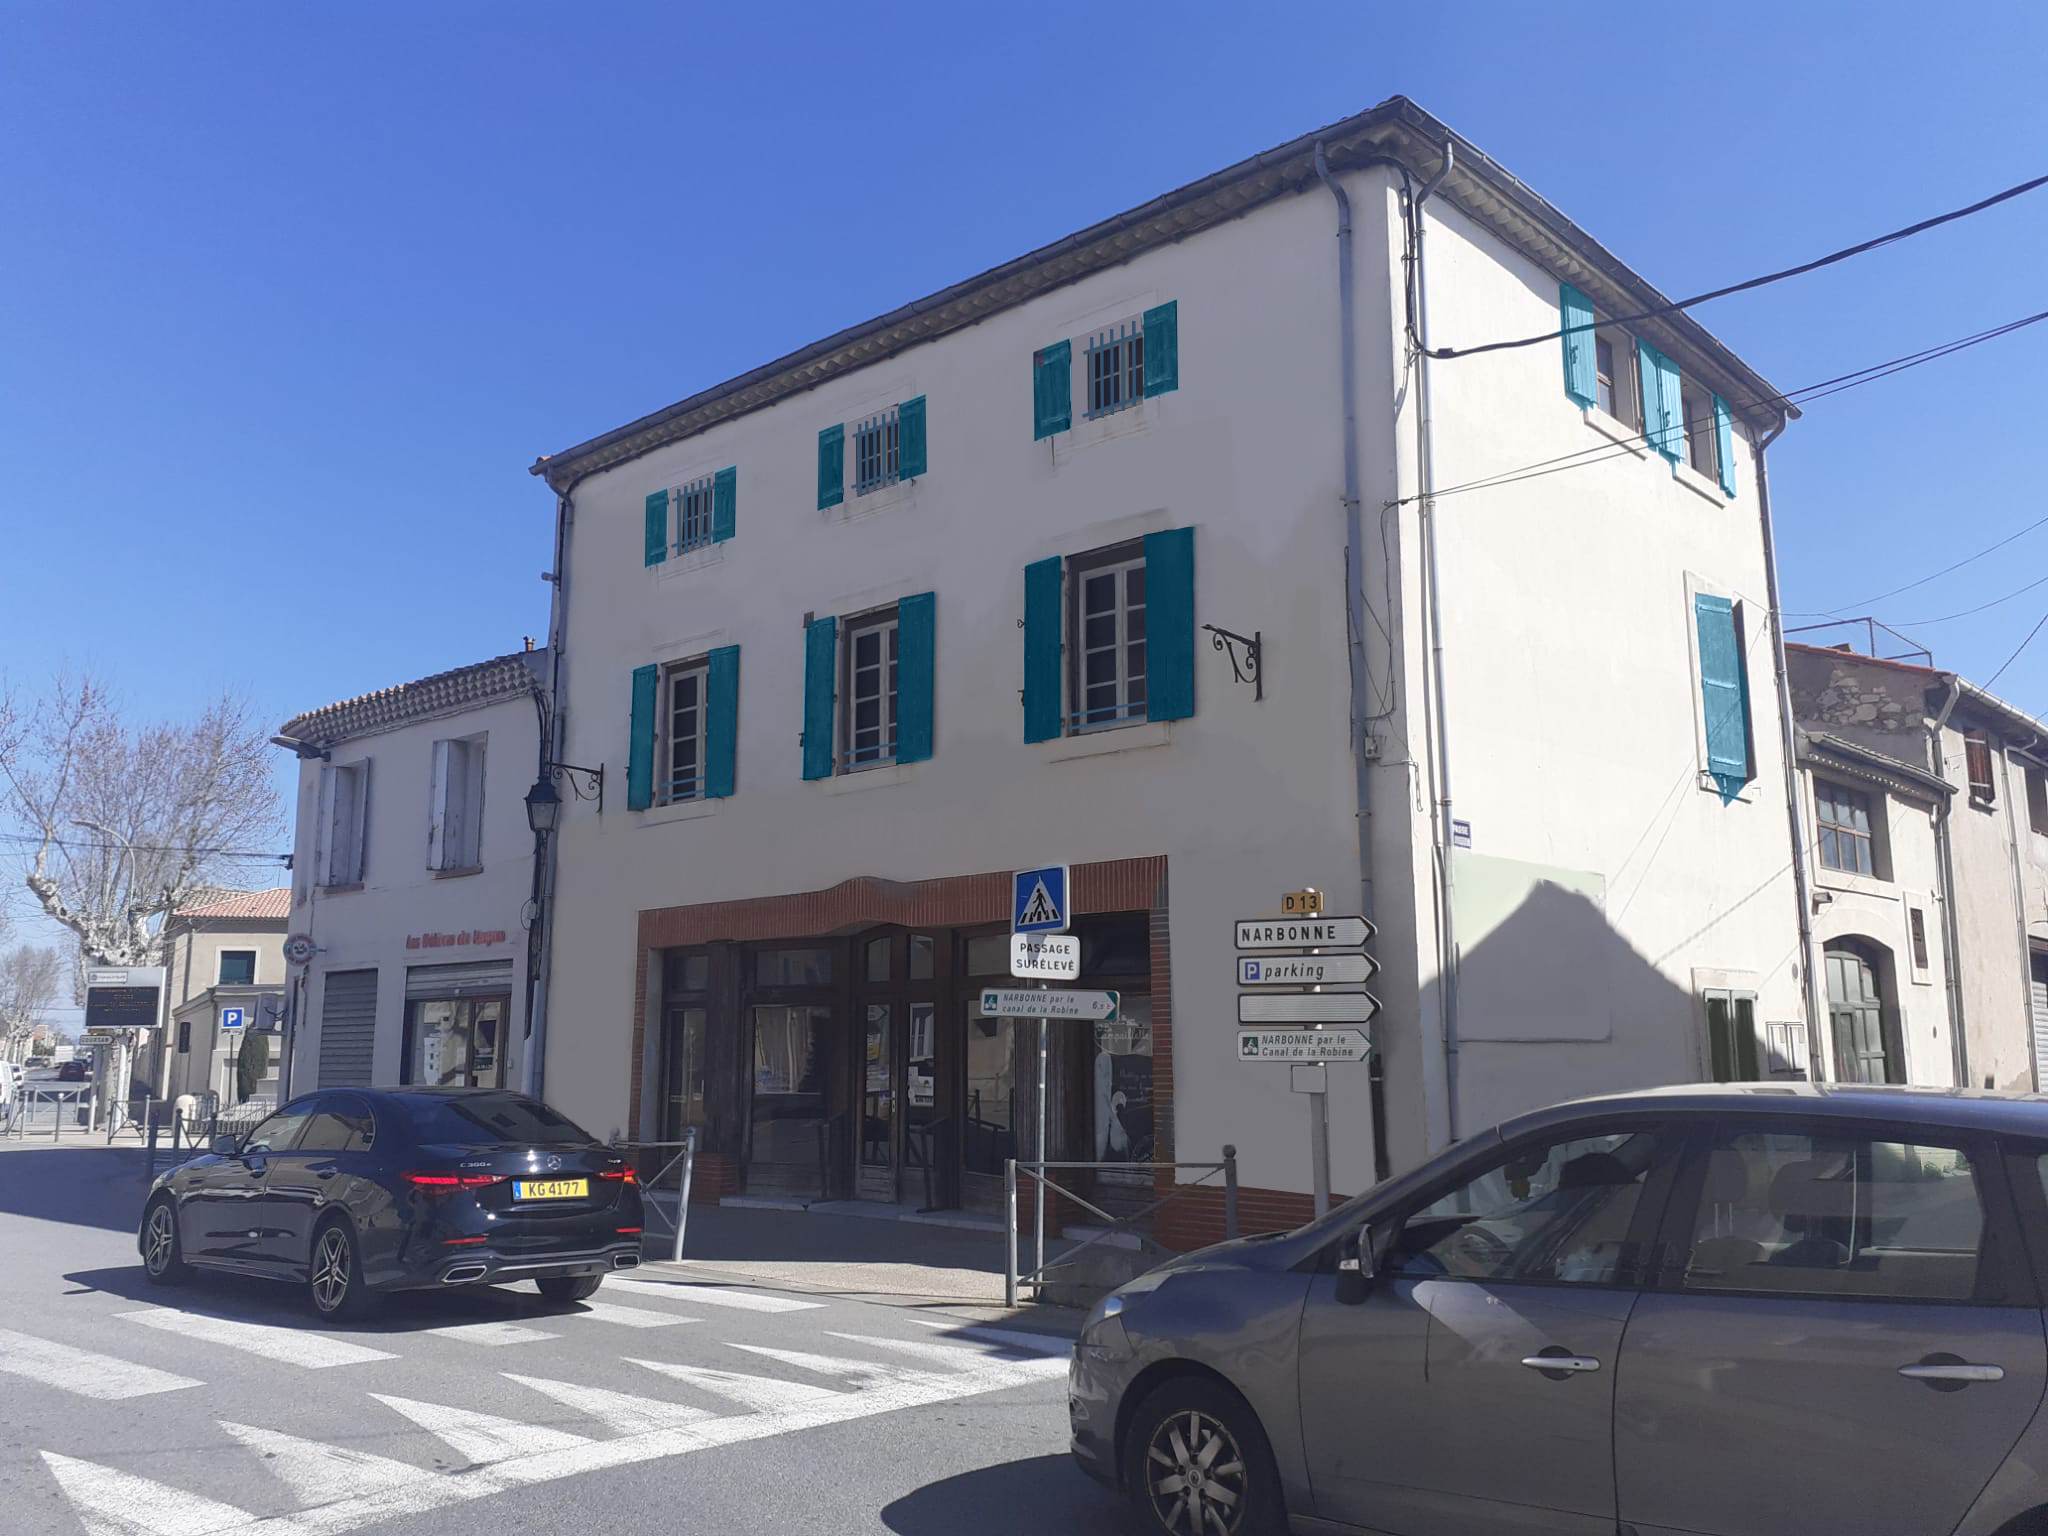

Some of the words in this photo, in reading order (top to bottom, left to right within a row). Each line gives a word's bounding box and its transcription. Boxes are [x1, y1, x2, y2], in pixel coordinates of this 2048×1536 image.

[1286, 897, 1295, 910] D
[1301, 895, 1317, 909] 13
[1242, 926, 1336, 942] NARBONNE
[1020, 943, 1070, 955] PASSAGE
[1016, 958, 1075, 971] SURÉLEVÉ
[1247, 963, 1257, 979] P
[1265, 963, 1324, 981] parking
[1003, 993, 1047, 1002] NARBONNE
[1050, 995, 1063, 1005] par
[1067, 994, 1074, 1003] le
[1002, 1005, 1024, 1013] canal
[1040, 1005, 1047, 1013] la
[1051, 1005, 1079, 1014] Robine
[227, 1011, 238, 1025] P
[1262, 1034, 1313, 1045] NARBONNE
[1317, 1037, 1334, 1047] par
[1337, 1035, 1346, 1044] le
[1262, 1047, 1288, 1057] Canal
[1292, 1048, 1303, 1056] de
[1307, 1047, 1316, 1056] la
[1320, 1047, 1353, 1057] Robine
[528, 1184, 546, 1197] KG
[548, 1182, 579, 1195] 4177
